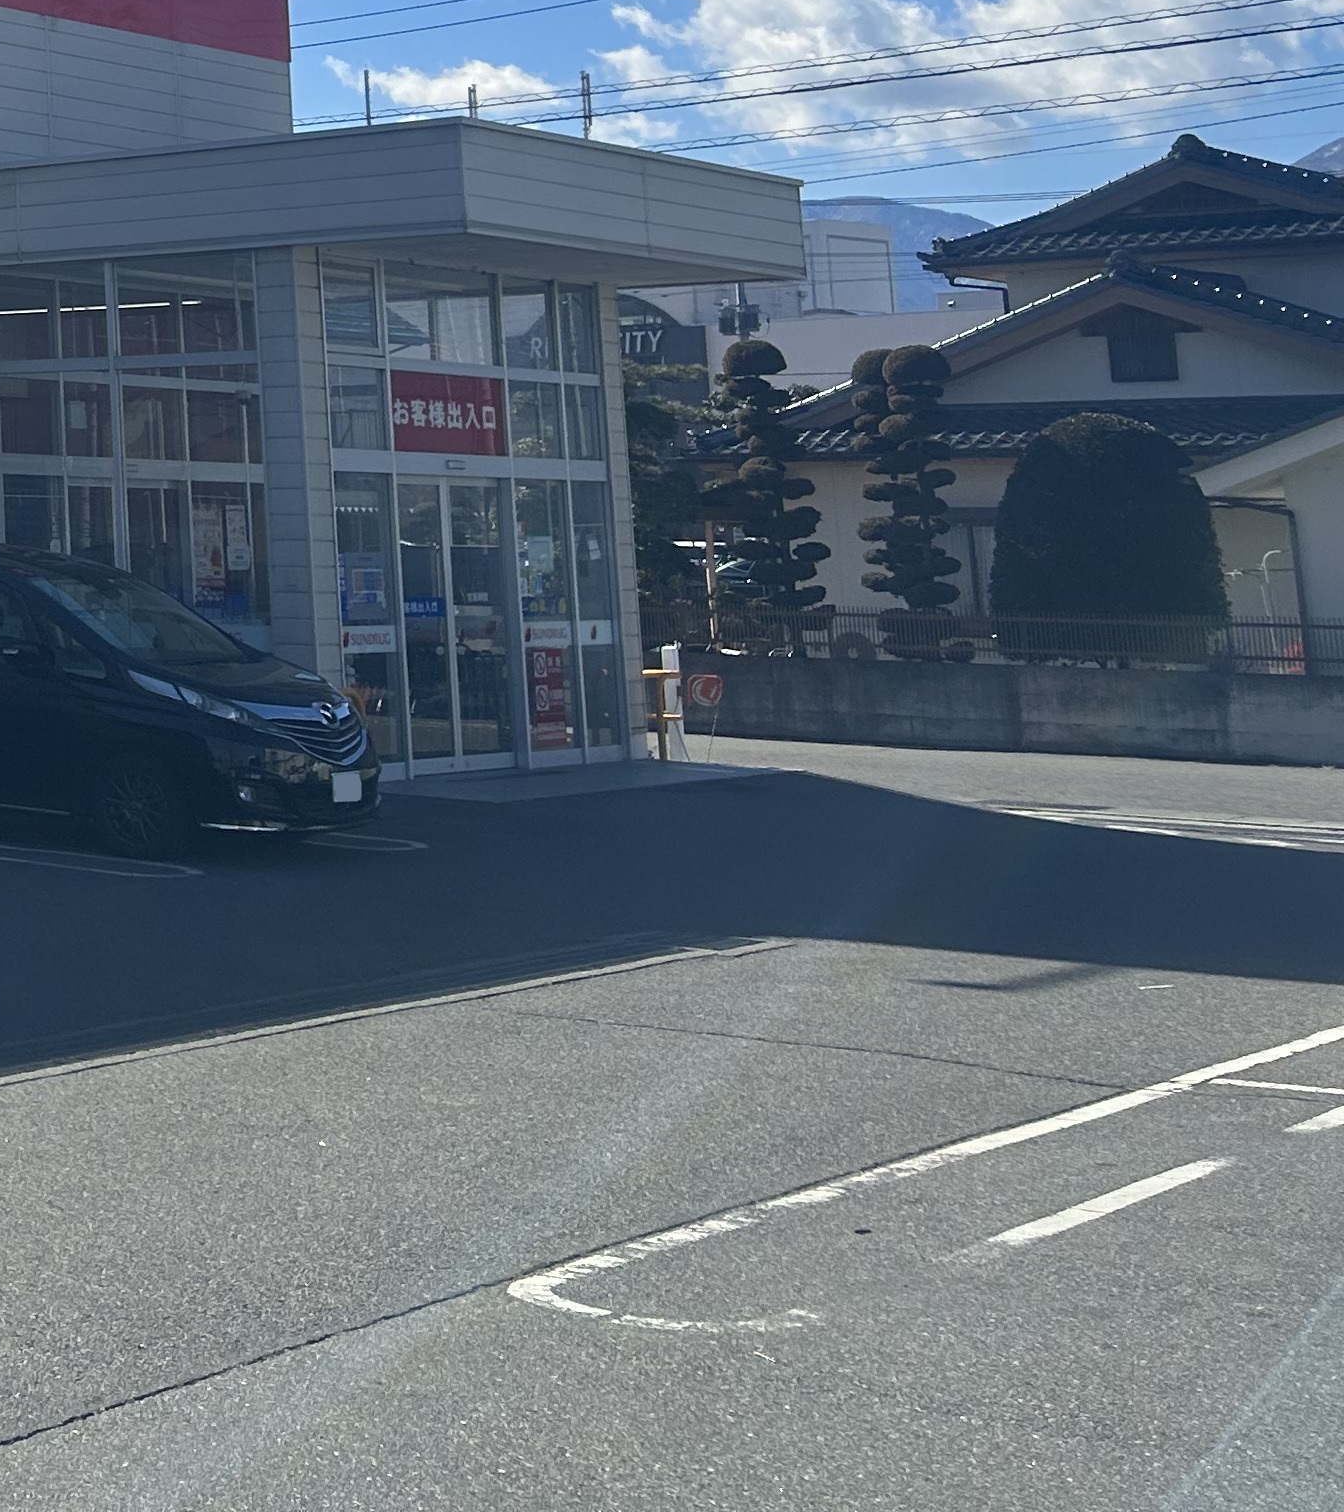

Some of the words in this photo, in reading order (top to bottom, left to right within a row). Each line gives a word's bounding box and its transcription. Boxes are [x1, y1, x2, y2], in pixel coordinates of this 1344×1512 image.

[619, 330, 663, 355] ITY
[393, 398, 496, 430] お客様出入口
